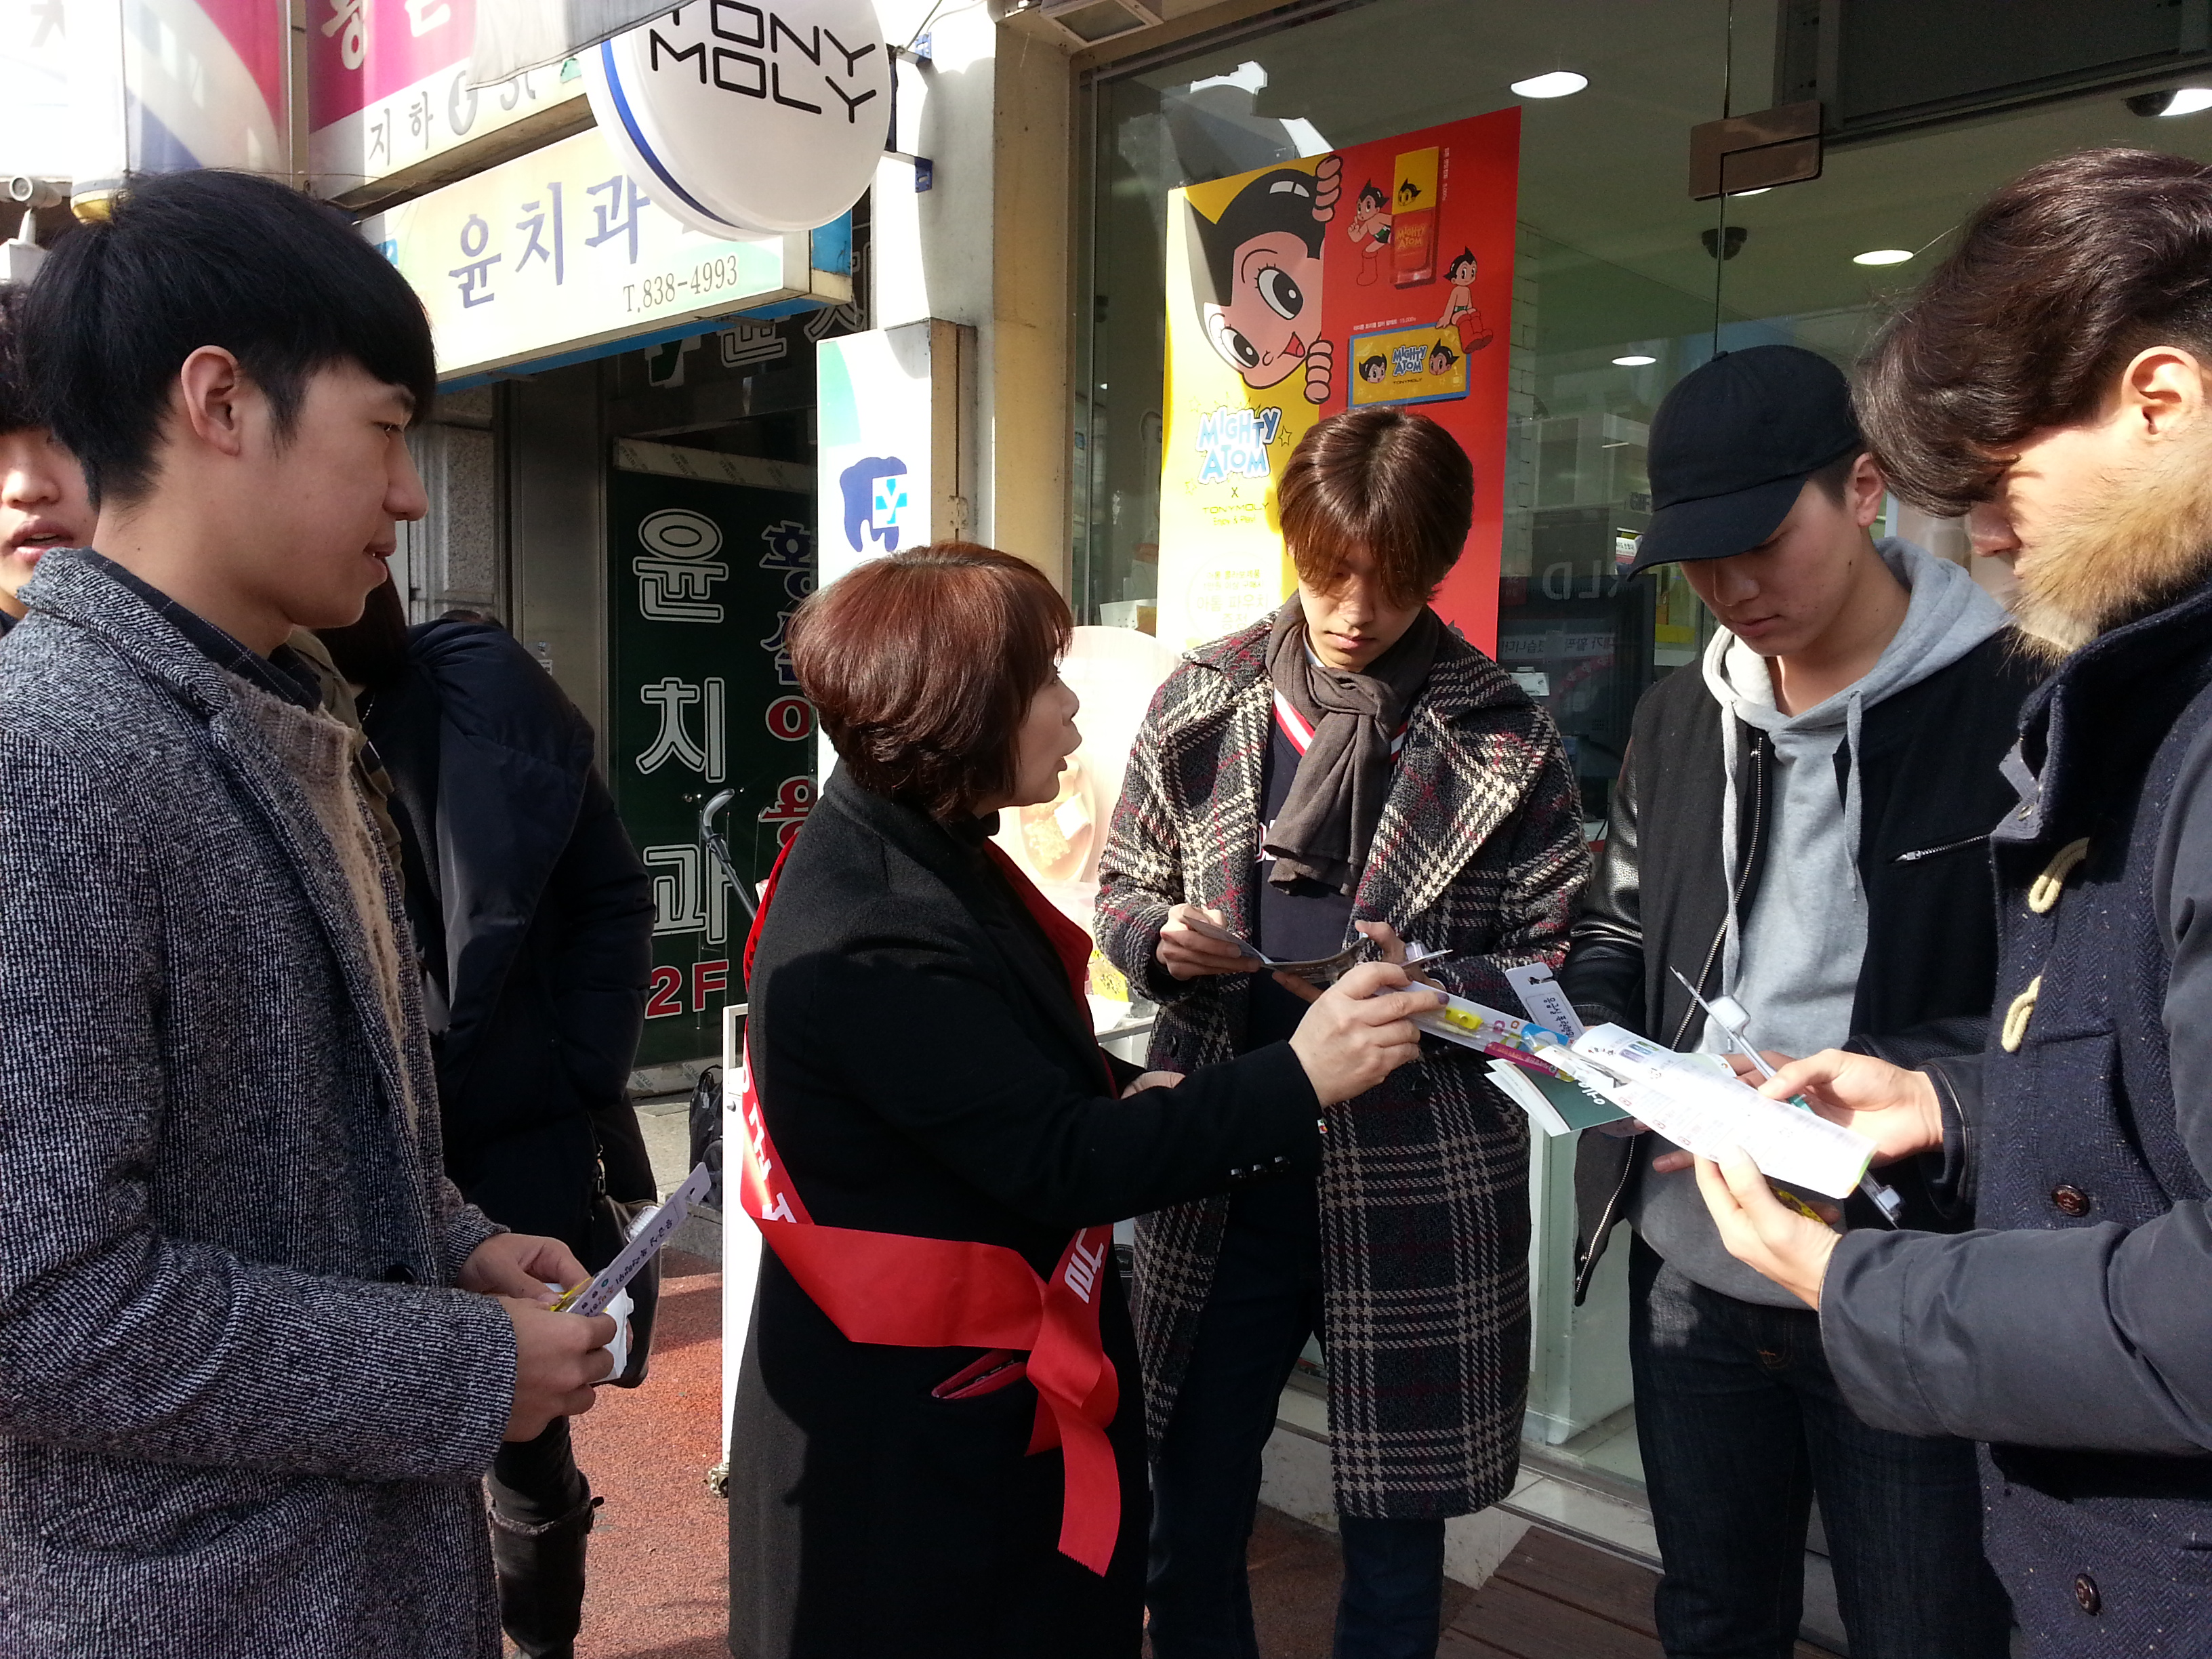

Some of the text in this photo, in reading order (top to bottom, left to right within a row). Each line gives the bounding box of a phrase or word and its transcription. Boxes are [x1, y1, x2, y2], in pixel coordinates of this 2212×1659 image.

[672, 0, 876, 77] ONY
[650, 28, 877, 123] MOLY
[369, 91, 434, 166] 지하
[448, 174, 651, 310] 윤치과
[623, 254, 738, 314] T.838-4993
[1391, 345, 1428, 364] MIGHTY
[1393, 360, 1423, 376] ATOM
[1196, 406, 1282, 452] MIGHTY
[1198, 445, 1271, 485] ATOM
[1202, 502, 1270, 514] TONYMOLY
[1197, 594, 1269, 612] 아톰 파우치
[1221, 613, 1248, 630] 증정
[644, 959, 729, 1019] 2F
